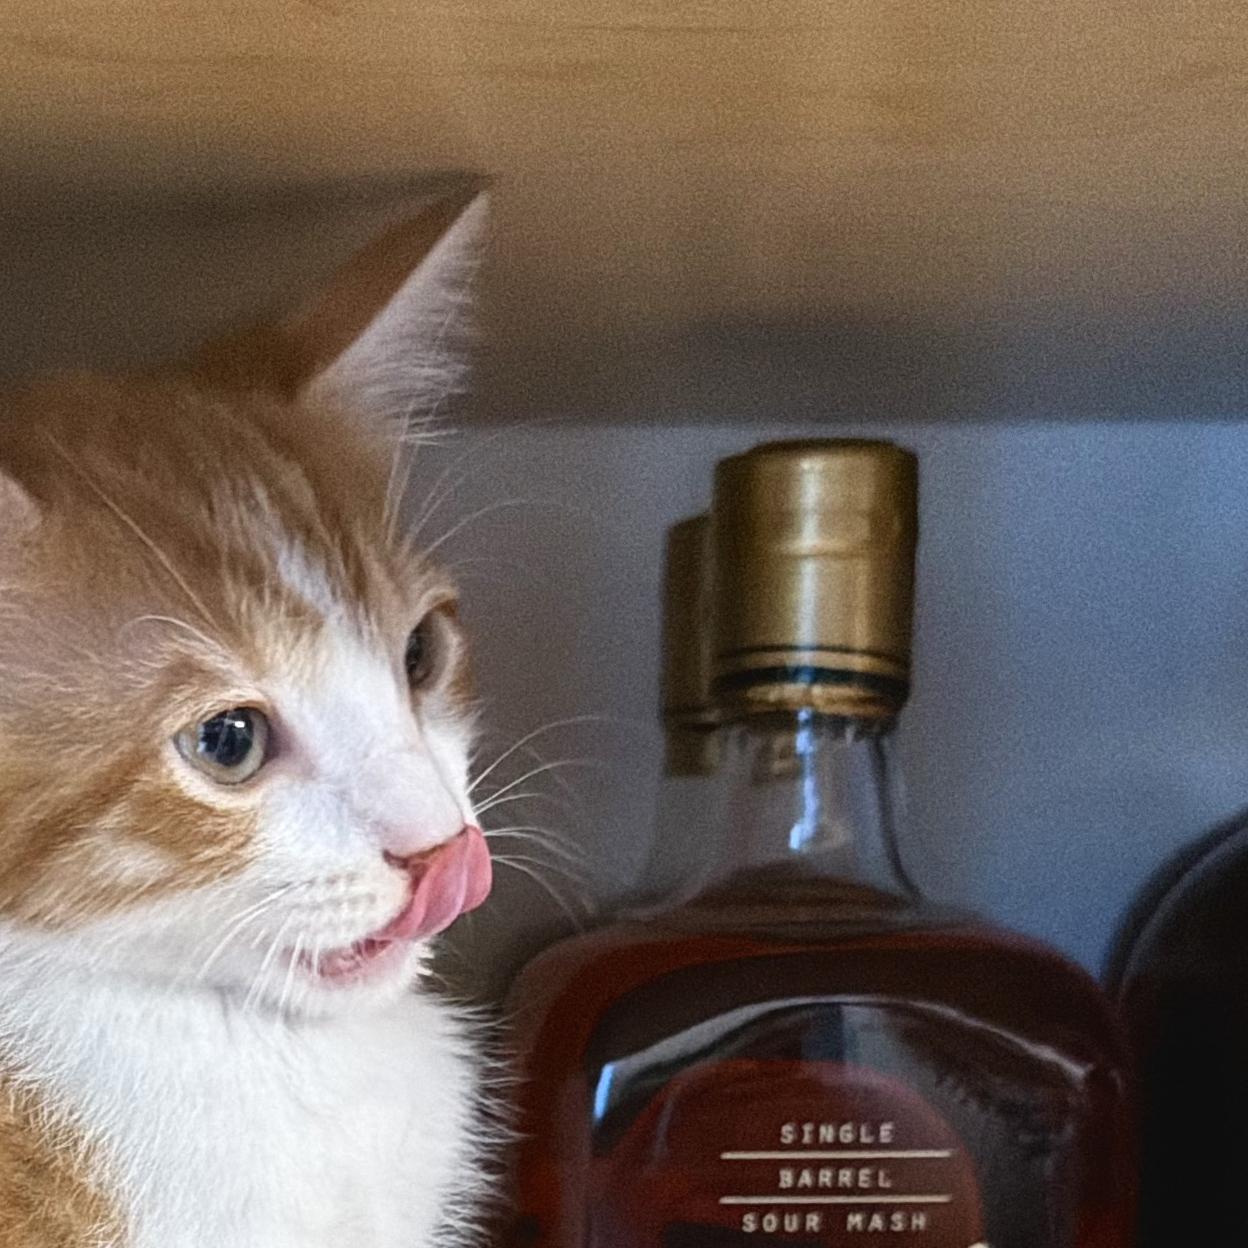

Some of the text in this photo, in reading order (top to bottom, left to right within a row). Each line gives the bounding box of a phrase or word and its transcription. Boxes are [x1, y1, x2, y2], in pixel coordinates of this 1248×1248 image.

[780, 1124, 895, 1144] SINGLE
[779, 1169, 892, 1189] BARREL
[742, 1212, 926, 1233] SOUR MASH
